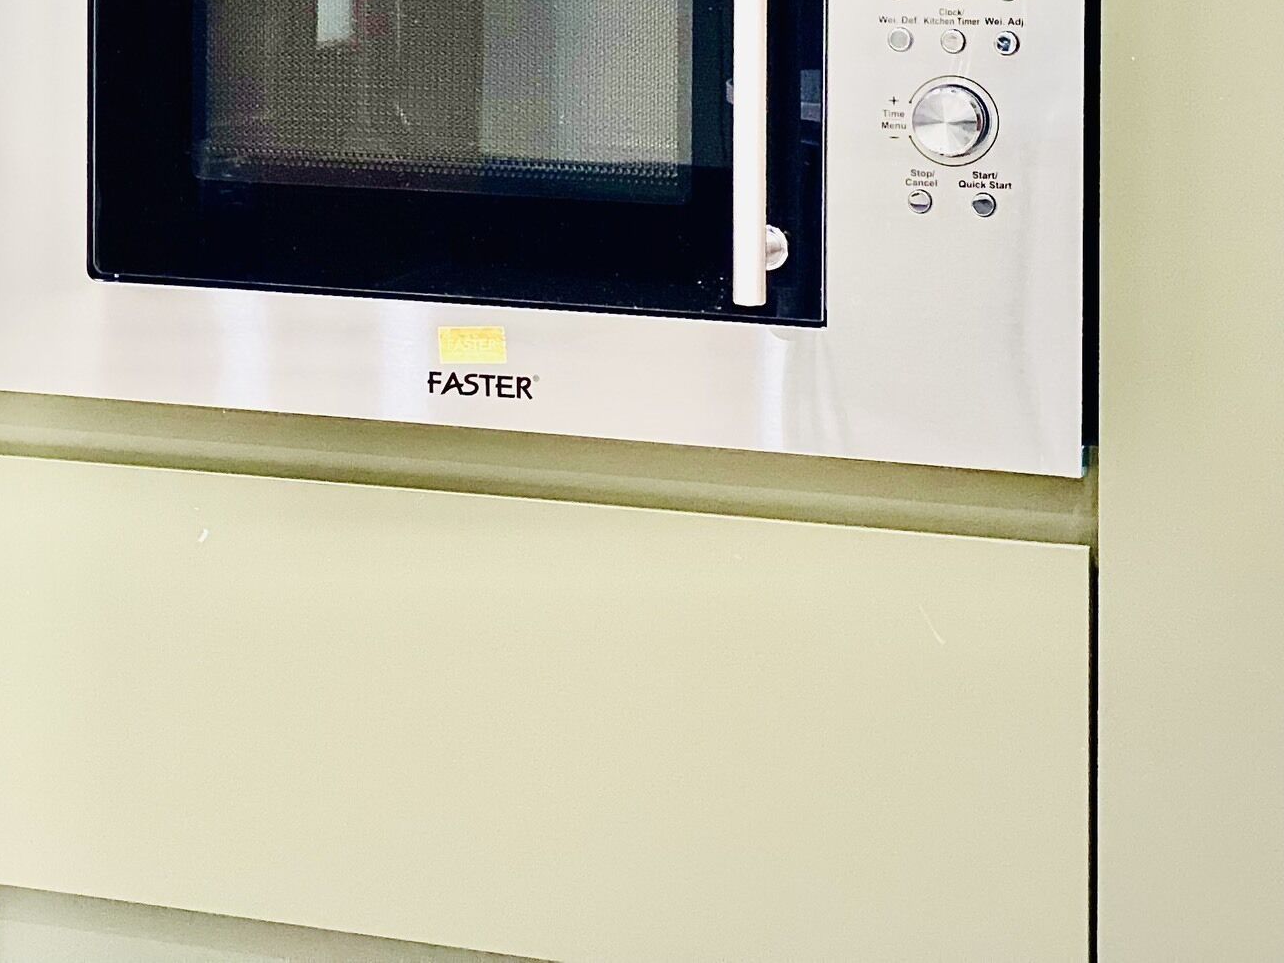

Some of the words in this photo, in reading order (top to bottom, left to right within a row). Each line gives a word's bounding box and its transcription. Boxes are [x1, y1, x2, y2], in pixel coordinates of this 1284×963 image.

[923, 17, 955, 26] Kitchen
[957, 17, 980, 26] Timer
[883, 109, 905, 118] Time
[881, 122, 907, 130] Menu
[910, 169, 935, 178] Stop/
[972, 171, 998, 180] Start/
[905, 179, 938, 187] Cancel
[958, 180, 986, 189] Quick
[989, 181, 1012, 190] Start
[427, 371, 533, 399] FASTER
